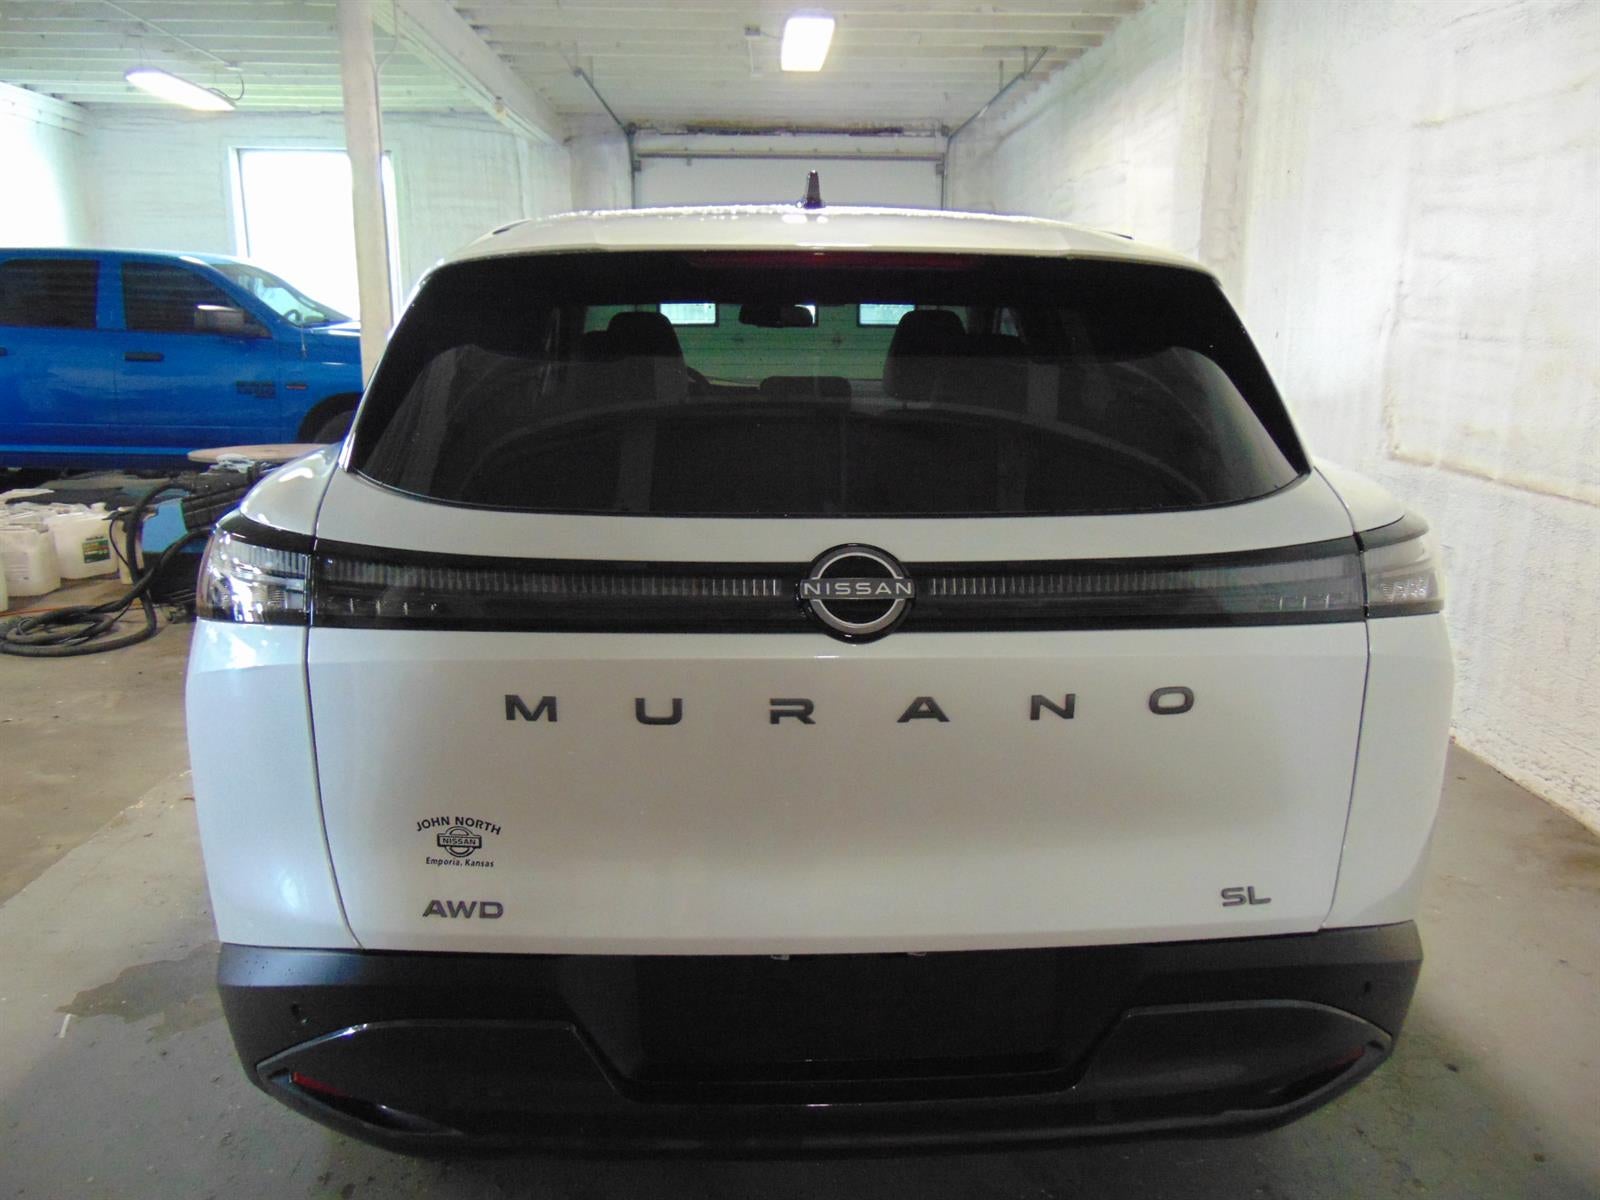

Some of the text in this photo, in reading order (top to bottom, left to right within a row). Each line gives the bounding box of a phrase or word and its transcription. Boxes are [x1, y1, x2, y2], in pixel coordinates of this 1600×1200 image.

[803, 582, 913, 595] NISSAN
[504, 686, 1195, 726] MURANO
[416, 816, 502, 835] JOHN NORTH
[425, 856, 495, 868] Emporia, Kansas
[1221, 886, 1272, 907] SL
[422, 899, 504, 919] AWD
